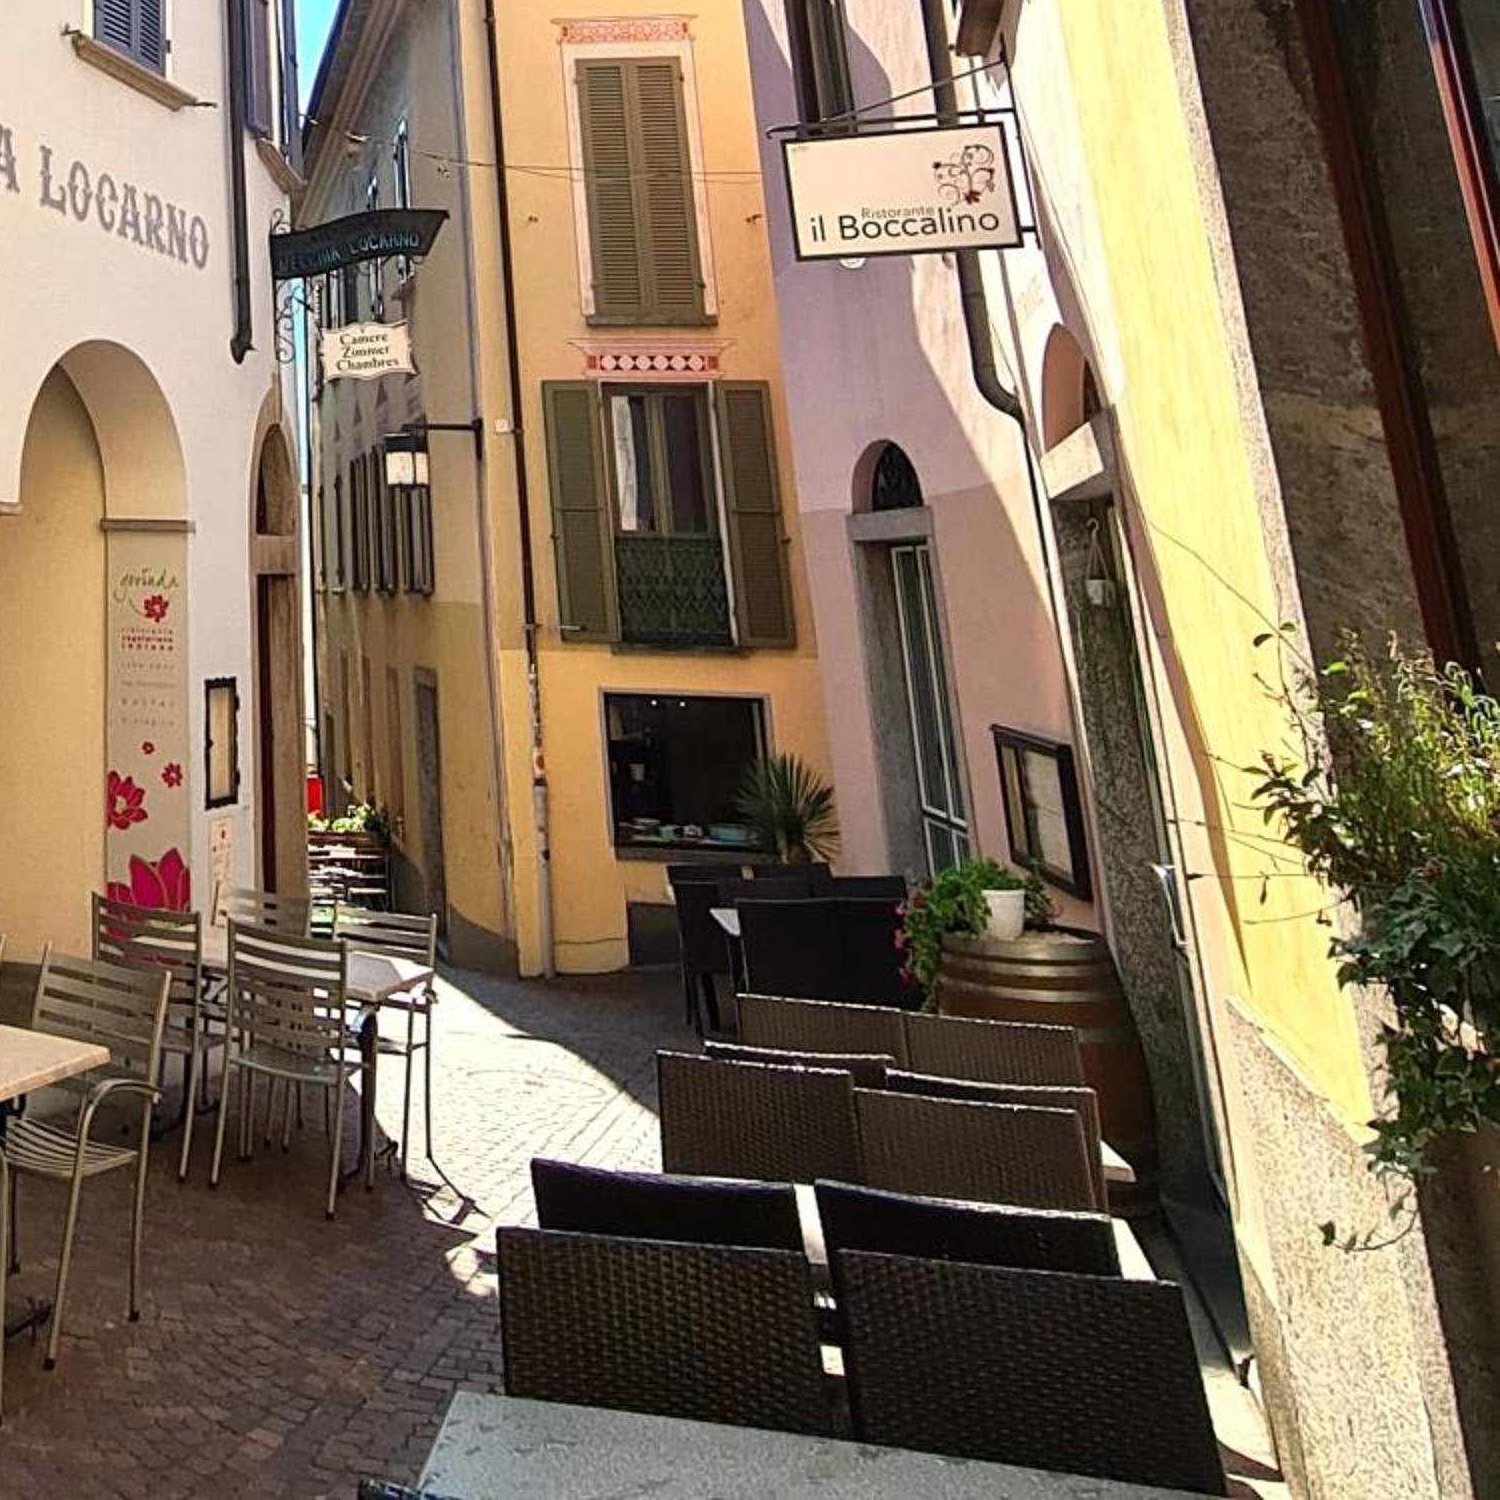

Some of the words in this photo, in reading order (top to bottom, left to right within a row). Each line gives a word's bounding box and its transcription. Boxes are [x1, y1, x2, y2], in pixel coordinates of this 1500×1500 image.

[40, 146, 210, 270] LOCARNO
[861, 205, 936, 220] Ristorante
[810, 216, 826, 242] il
[839, 206, 1000, 240] Boccalino
[340, 333, 388, 346] Camere
[341, 346, 389, 359] Zimmer
[336, 358, 399, 372] Chambres
